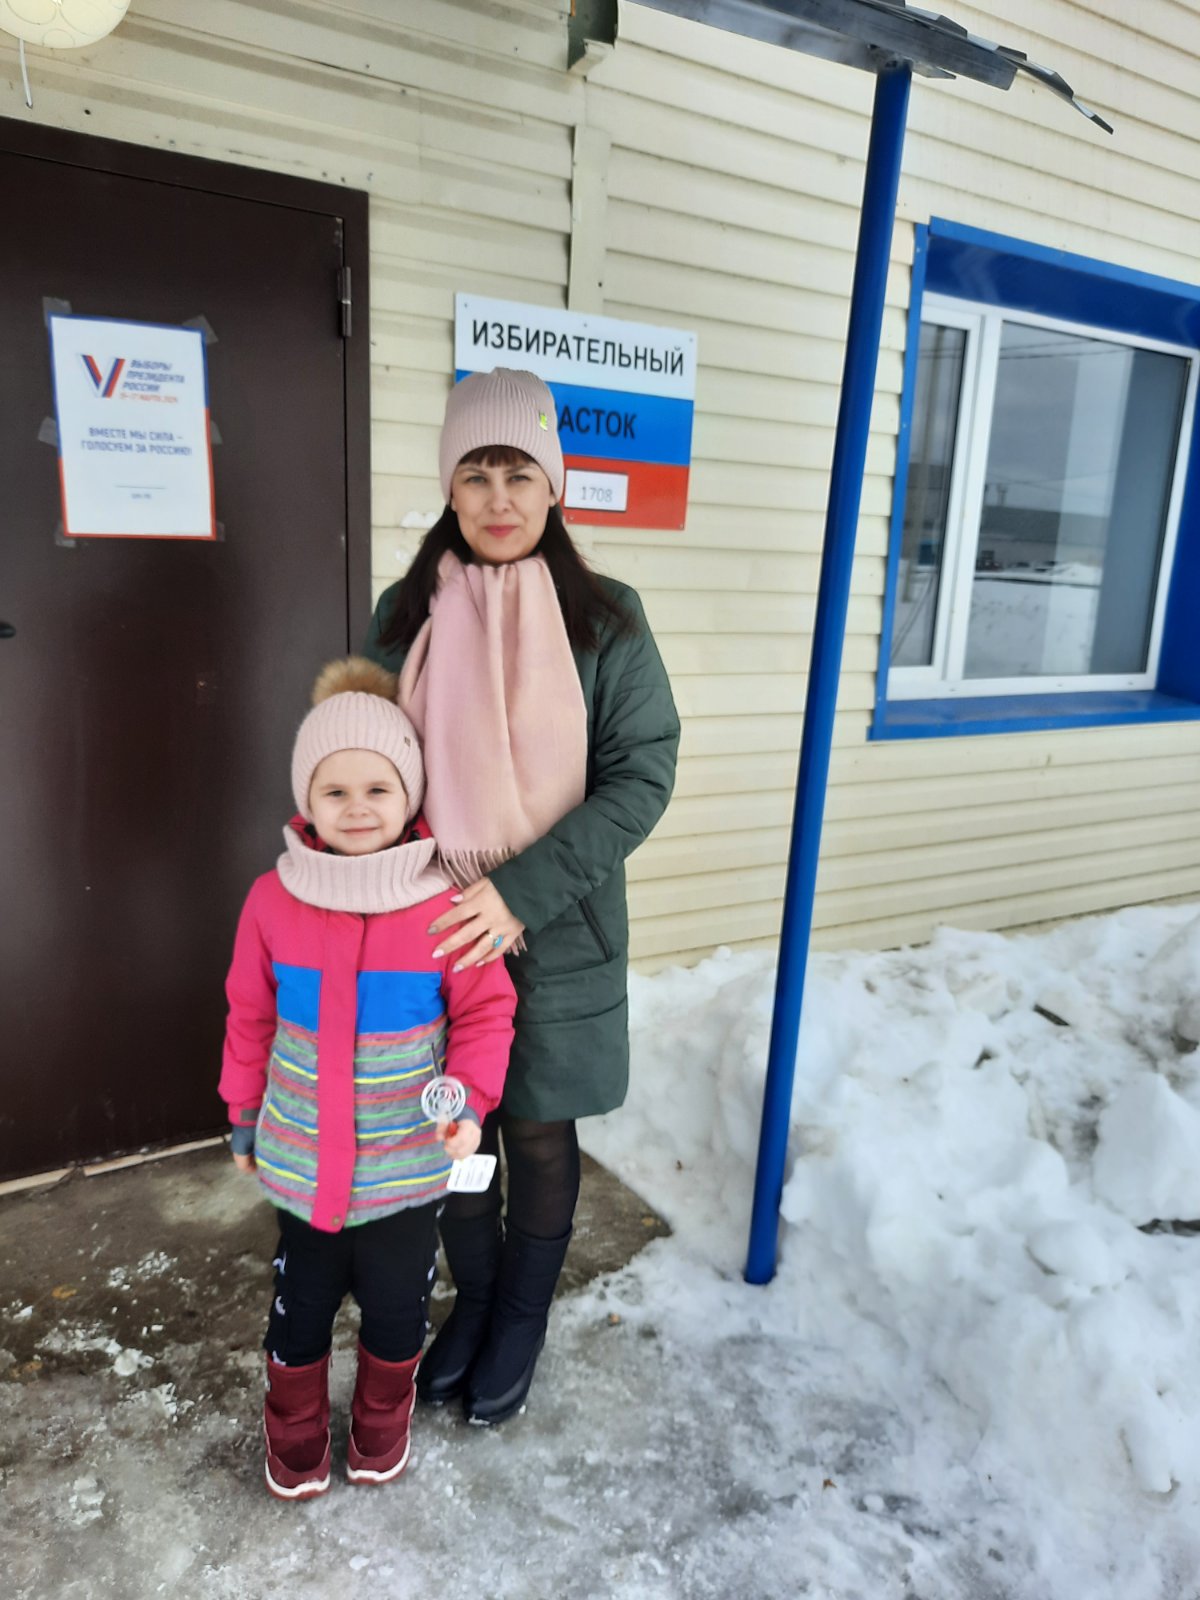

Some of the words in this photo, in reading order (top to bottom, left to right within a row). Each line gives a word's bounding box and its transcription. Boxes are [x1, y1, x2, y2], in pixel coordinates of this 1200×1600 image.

[472, 319, 685, 377] ИЗБИРАТЕЛЬНЫЙ
[556, 405, 637, 440] АСТОК
[88, 427, 126, 439] ВМЕСТЕ
[129, 429, 147, 440] МЫ
[149, 431, 175, 442] СИЛА
[81, 439, 133, 453] ГОЛОСУЕМ
[135, 443, 147, 453] ЗА
[580, 485, 614, 504] 1708
